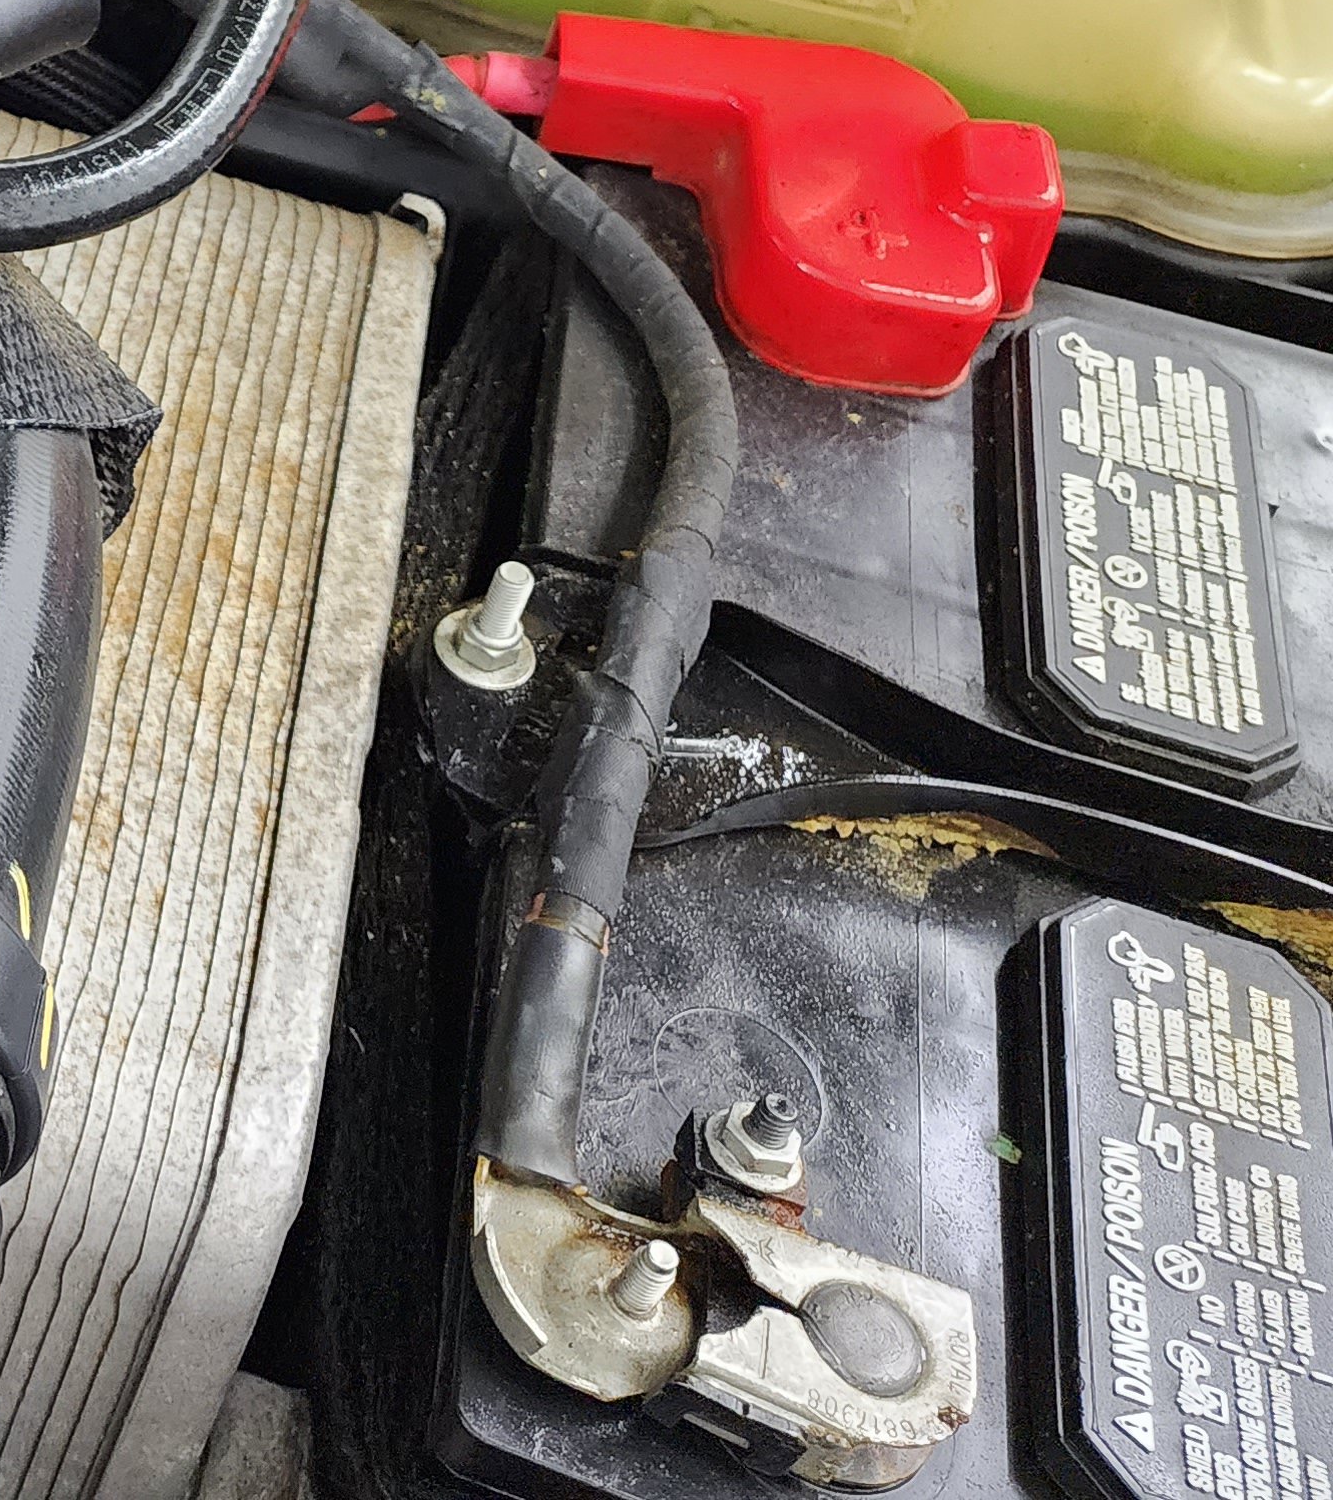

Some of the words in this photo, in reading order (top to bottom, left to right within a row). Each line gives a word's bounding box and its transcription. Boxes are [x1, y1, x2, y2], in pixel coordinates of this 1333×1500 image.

[1061, 472, 1105, 652] DANGER/POISON
[1187, 1122, 1217, 1165] ACID
[1100, 1136, 1155, 1407] DANGER/POISON
[1198, 1294, 1227, 1327] NO
[948, 1328, 972, 1394] ROYAL
[1232, 1356, 1264, 1417] GASES
[1182, 1424, 1215, 1493] SHIELD
